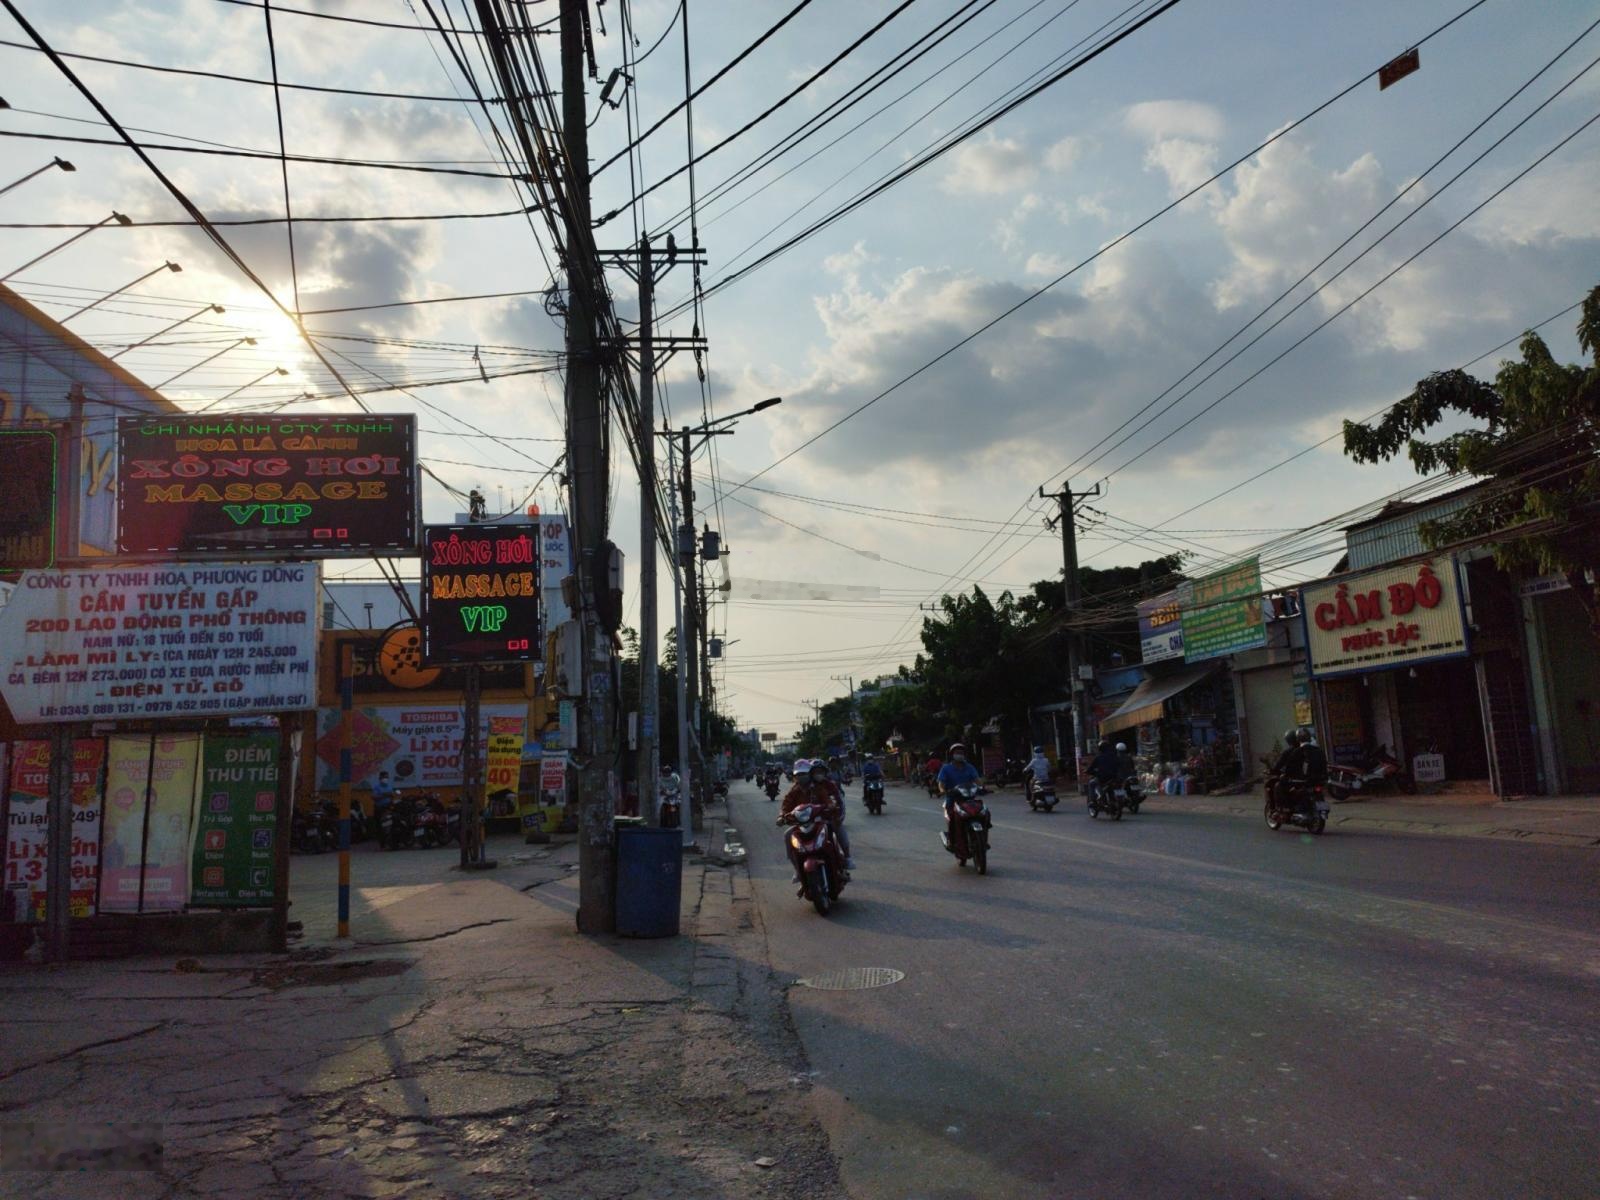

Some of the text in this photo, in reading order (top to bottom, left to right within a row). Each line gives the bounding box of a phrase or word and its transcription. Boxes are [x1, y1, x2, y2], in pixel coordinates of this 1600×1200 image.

[140, 422, 393, 435] CHI NHÁNH CTY TNHH
[176, 439, 238, 452] HOA
[131, 453, 400, 478] XÔNG HƠI
[144, 481, 388, 503] MASSAGE
[222, 502, 312, 525] VIP
[432, 533, 533, 565] XÔNG HƠI
[27, 574, 71, 589] CÔNG
[79, 574, 100, 588] TY
[108, 573, 148, 588] TNHH
[154, 570, 187, 586] HOA
[193, 568, 257, 584] PHƯƠNG
[432, 571, 535, 600] MASSAGE
[80, 587, 259, 612] CẦN TUYỂN GẤP
[1314, 583, 1385, 631] CẦM
[1388, 557, 1443, 616] ĐỒ
[26, 608, 306, 632] 200 LAO ĐỘNG PHỔ THÔNG
[460, 604, 507, 633] VIP
[83, 636, 115, 649] NAM
[144, 634, 155, 645] 18
[190, 631, 214, 645] ĐẾN
[219, 632, 234, 644] 50
[1341, 621, 1421, 652] PHÚC LỘC
[163, 648, 184, 662] (CA
[188, 647, 220, 661] NGÀY
[224, 647, 244, 659] 12H
[249, 645, 297, 658] 245.000
[8, 673, 25, 685] CA
[33, 668, 61, 684] ĐÊM
[66, 670, 87, 682] 12H
[169, 667, 186, 679] XE
[190, 665, 216, 677] ĐƯA
[289, 657, 309, 672] PHÍ
[110, 680, 164, 697] ĐIỆN
[213, 677, 243, 693] GỖ
[60, 704, 89, 716] 0345
[118, 702, 135, 713] 131
[176, 699, 198, 711] 452
[253, 694, 285, 707] NHÂN
[404, 713, 456, 722] TOSHIBA
[224, 743, 272, 764] ĐIỂM
[208, 767, 244, 783] THU
